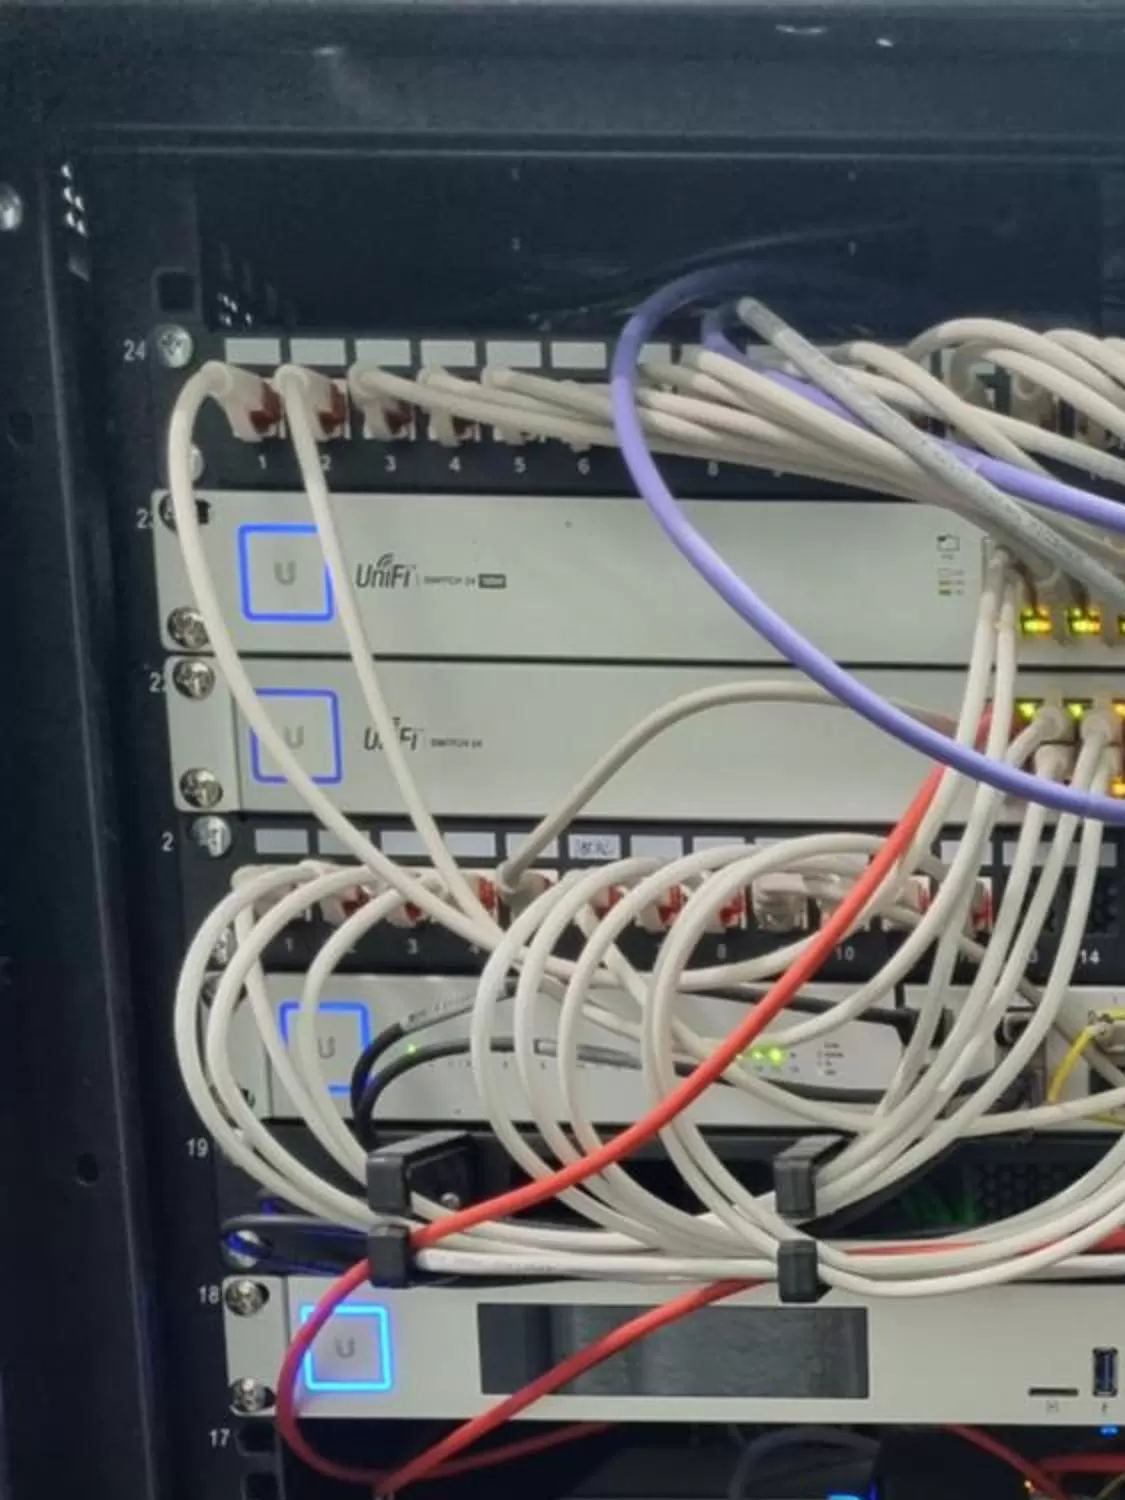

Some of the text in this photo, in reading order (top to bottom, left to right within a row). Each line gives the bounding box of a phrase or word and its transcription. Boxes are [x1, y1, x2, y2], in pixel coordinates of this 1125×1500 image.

[124, 339, 146, 361] 24
[259, 456, 266, 469] 1
[386, 456, 396, 471] 3
[449, 457, 460, 471] 4
[514, 457, 526, 473] 5
[577, 458, 590, 475] 6
[356, 554, 411, 588] UniFi
[364, 719, 417, 750] UFi
[285, 938, 292, 951] 1
[1080, 949, 1100, 964] 14
[188, 1138, 208, 1157] 19
[200, 1286, 220, 1303] 18
[210, 1428, 230, 1446] 17
